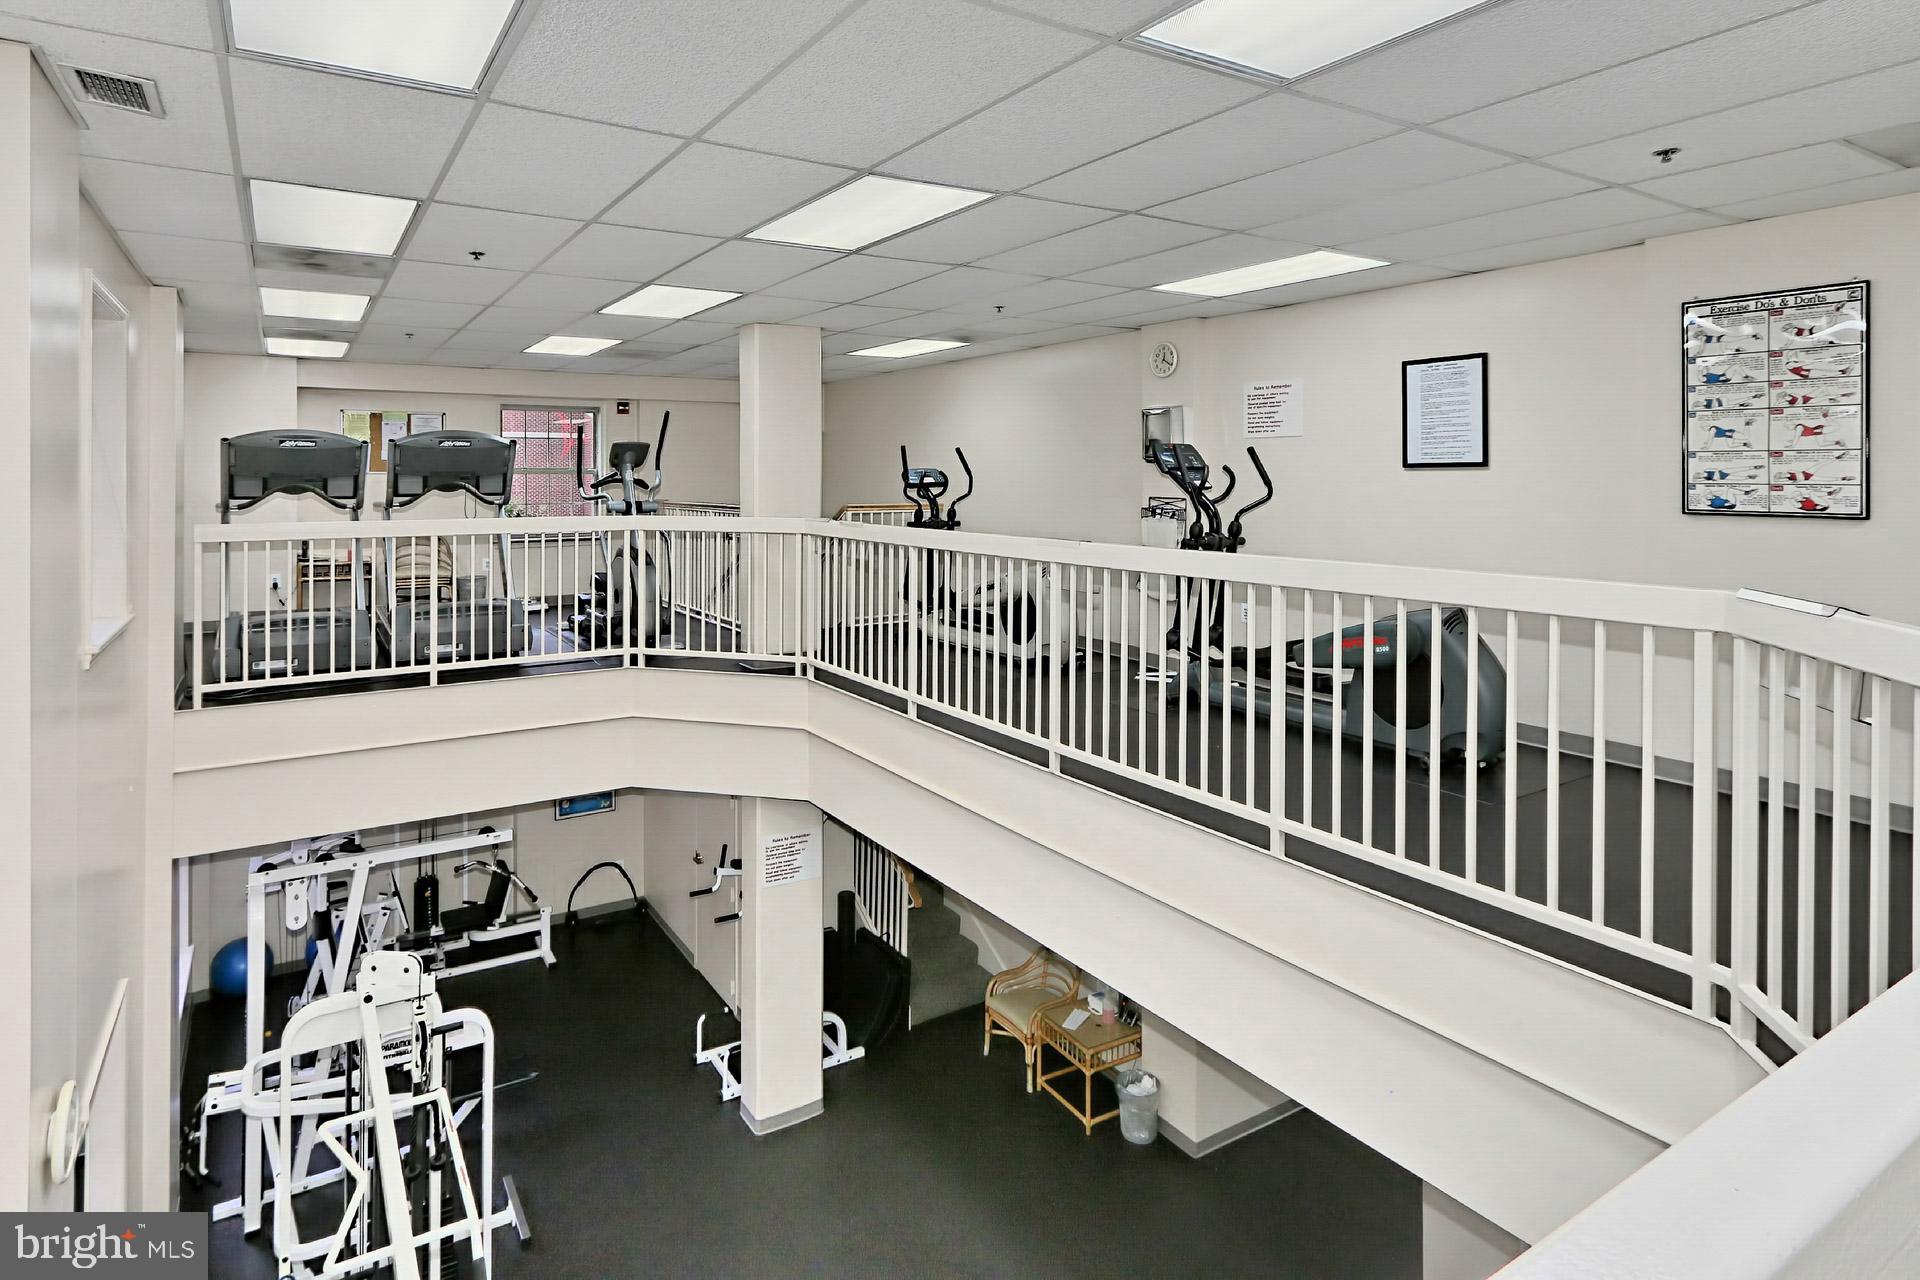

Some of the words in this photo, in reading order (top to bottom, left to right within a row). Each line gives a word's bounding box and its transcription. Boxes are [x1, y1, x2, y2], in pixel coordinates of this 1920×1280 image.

[1710, 303, 1750, 314] Exercise
[1755, 299, 1775, 310] Do's
[1780, 297, 1789, 307] &
